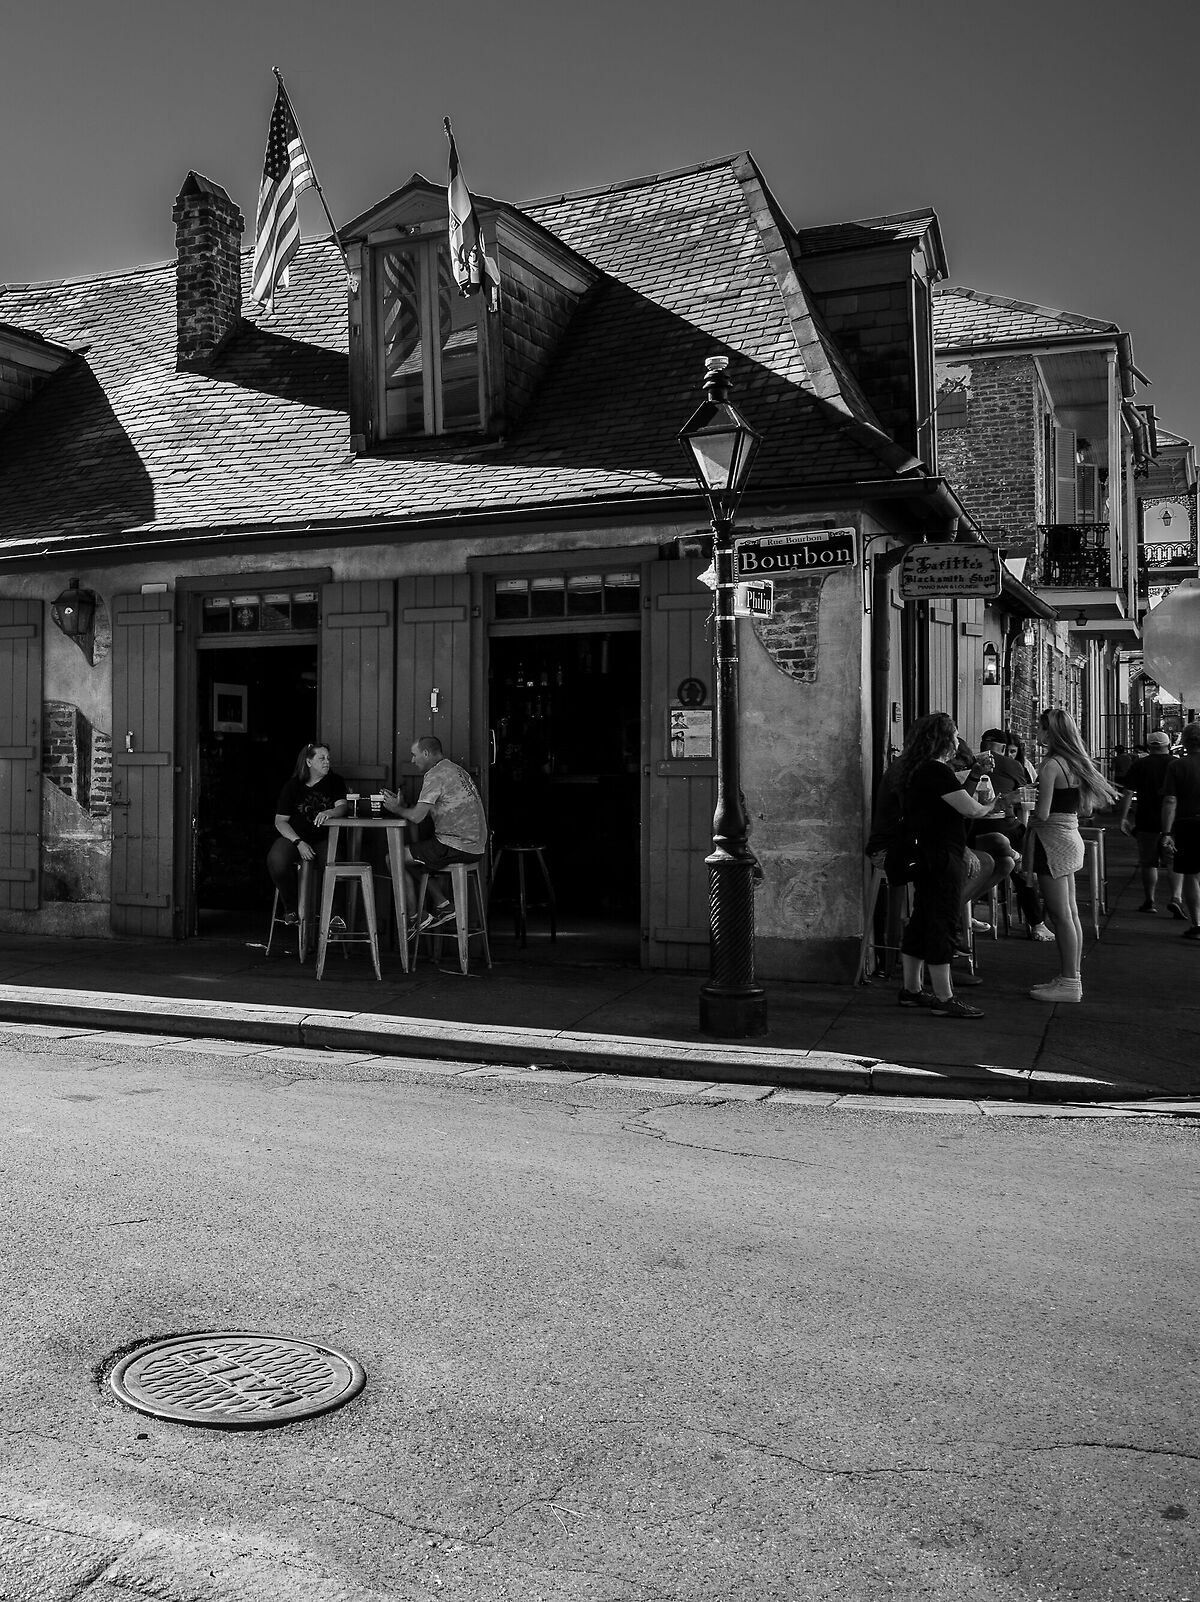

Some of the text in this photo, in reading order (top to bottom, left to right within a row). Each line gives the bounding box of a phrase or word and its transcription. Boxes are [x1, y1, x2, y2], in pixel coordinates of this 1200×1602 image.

[767, 535, 822, 546] Rue Bourbon
[741, 546, 851, 571] Bourbon
[915, 556, 983, 574] Lafitte's
[903, 573, 995, 585] Blacksmith Shop
[746, 590, 771, 614] Philip
